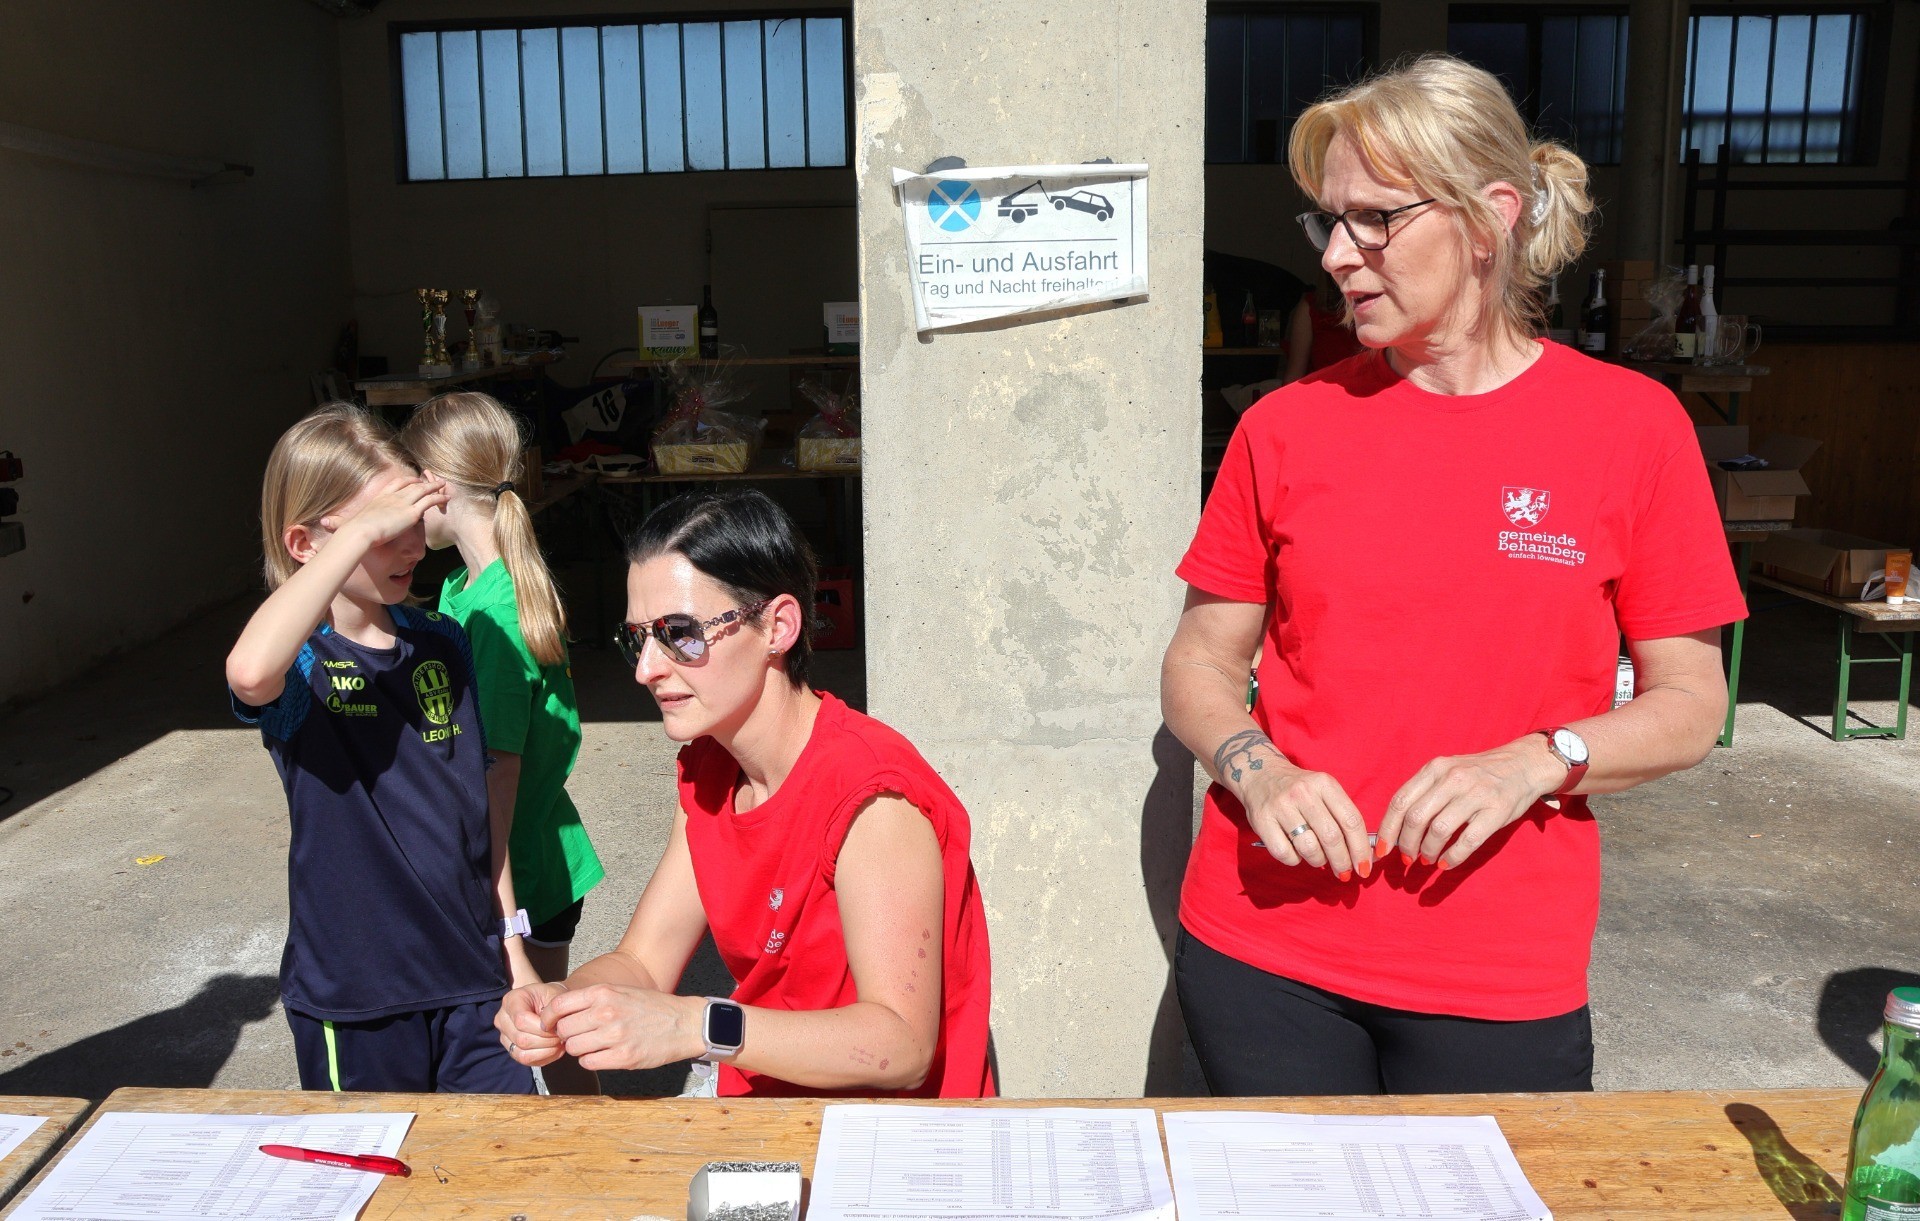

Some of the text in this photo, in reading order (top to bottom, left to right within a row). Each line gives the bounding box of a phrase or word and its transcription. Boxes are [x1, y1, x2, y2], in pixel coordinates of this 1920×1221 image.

[918, 250, 1119, 275] Ein- und Ausfahrt
[921, 281, 949, 298] Tag
[955, 280, 984, 295] und
[990, 279, 1036, 293] Nacht
[1498, 530, 1577, 547] gemeinde
[1498, 539, 1587, 564] behamberg
[1508, 552, 1536, 560] einfach
[344, 703, 377, 712] BAUER
